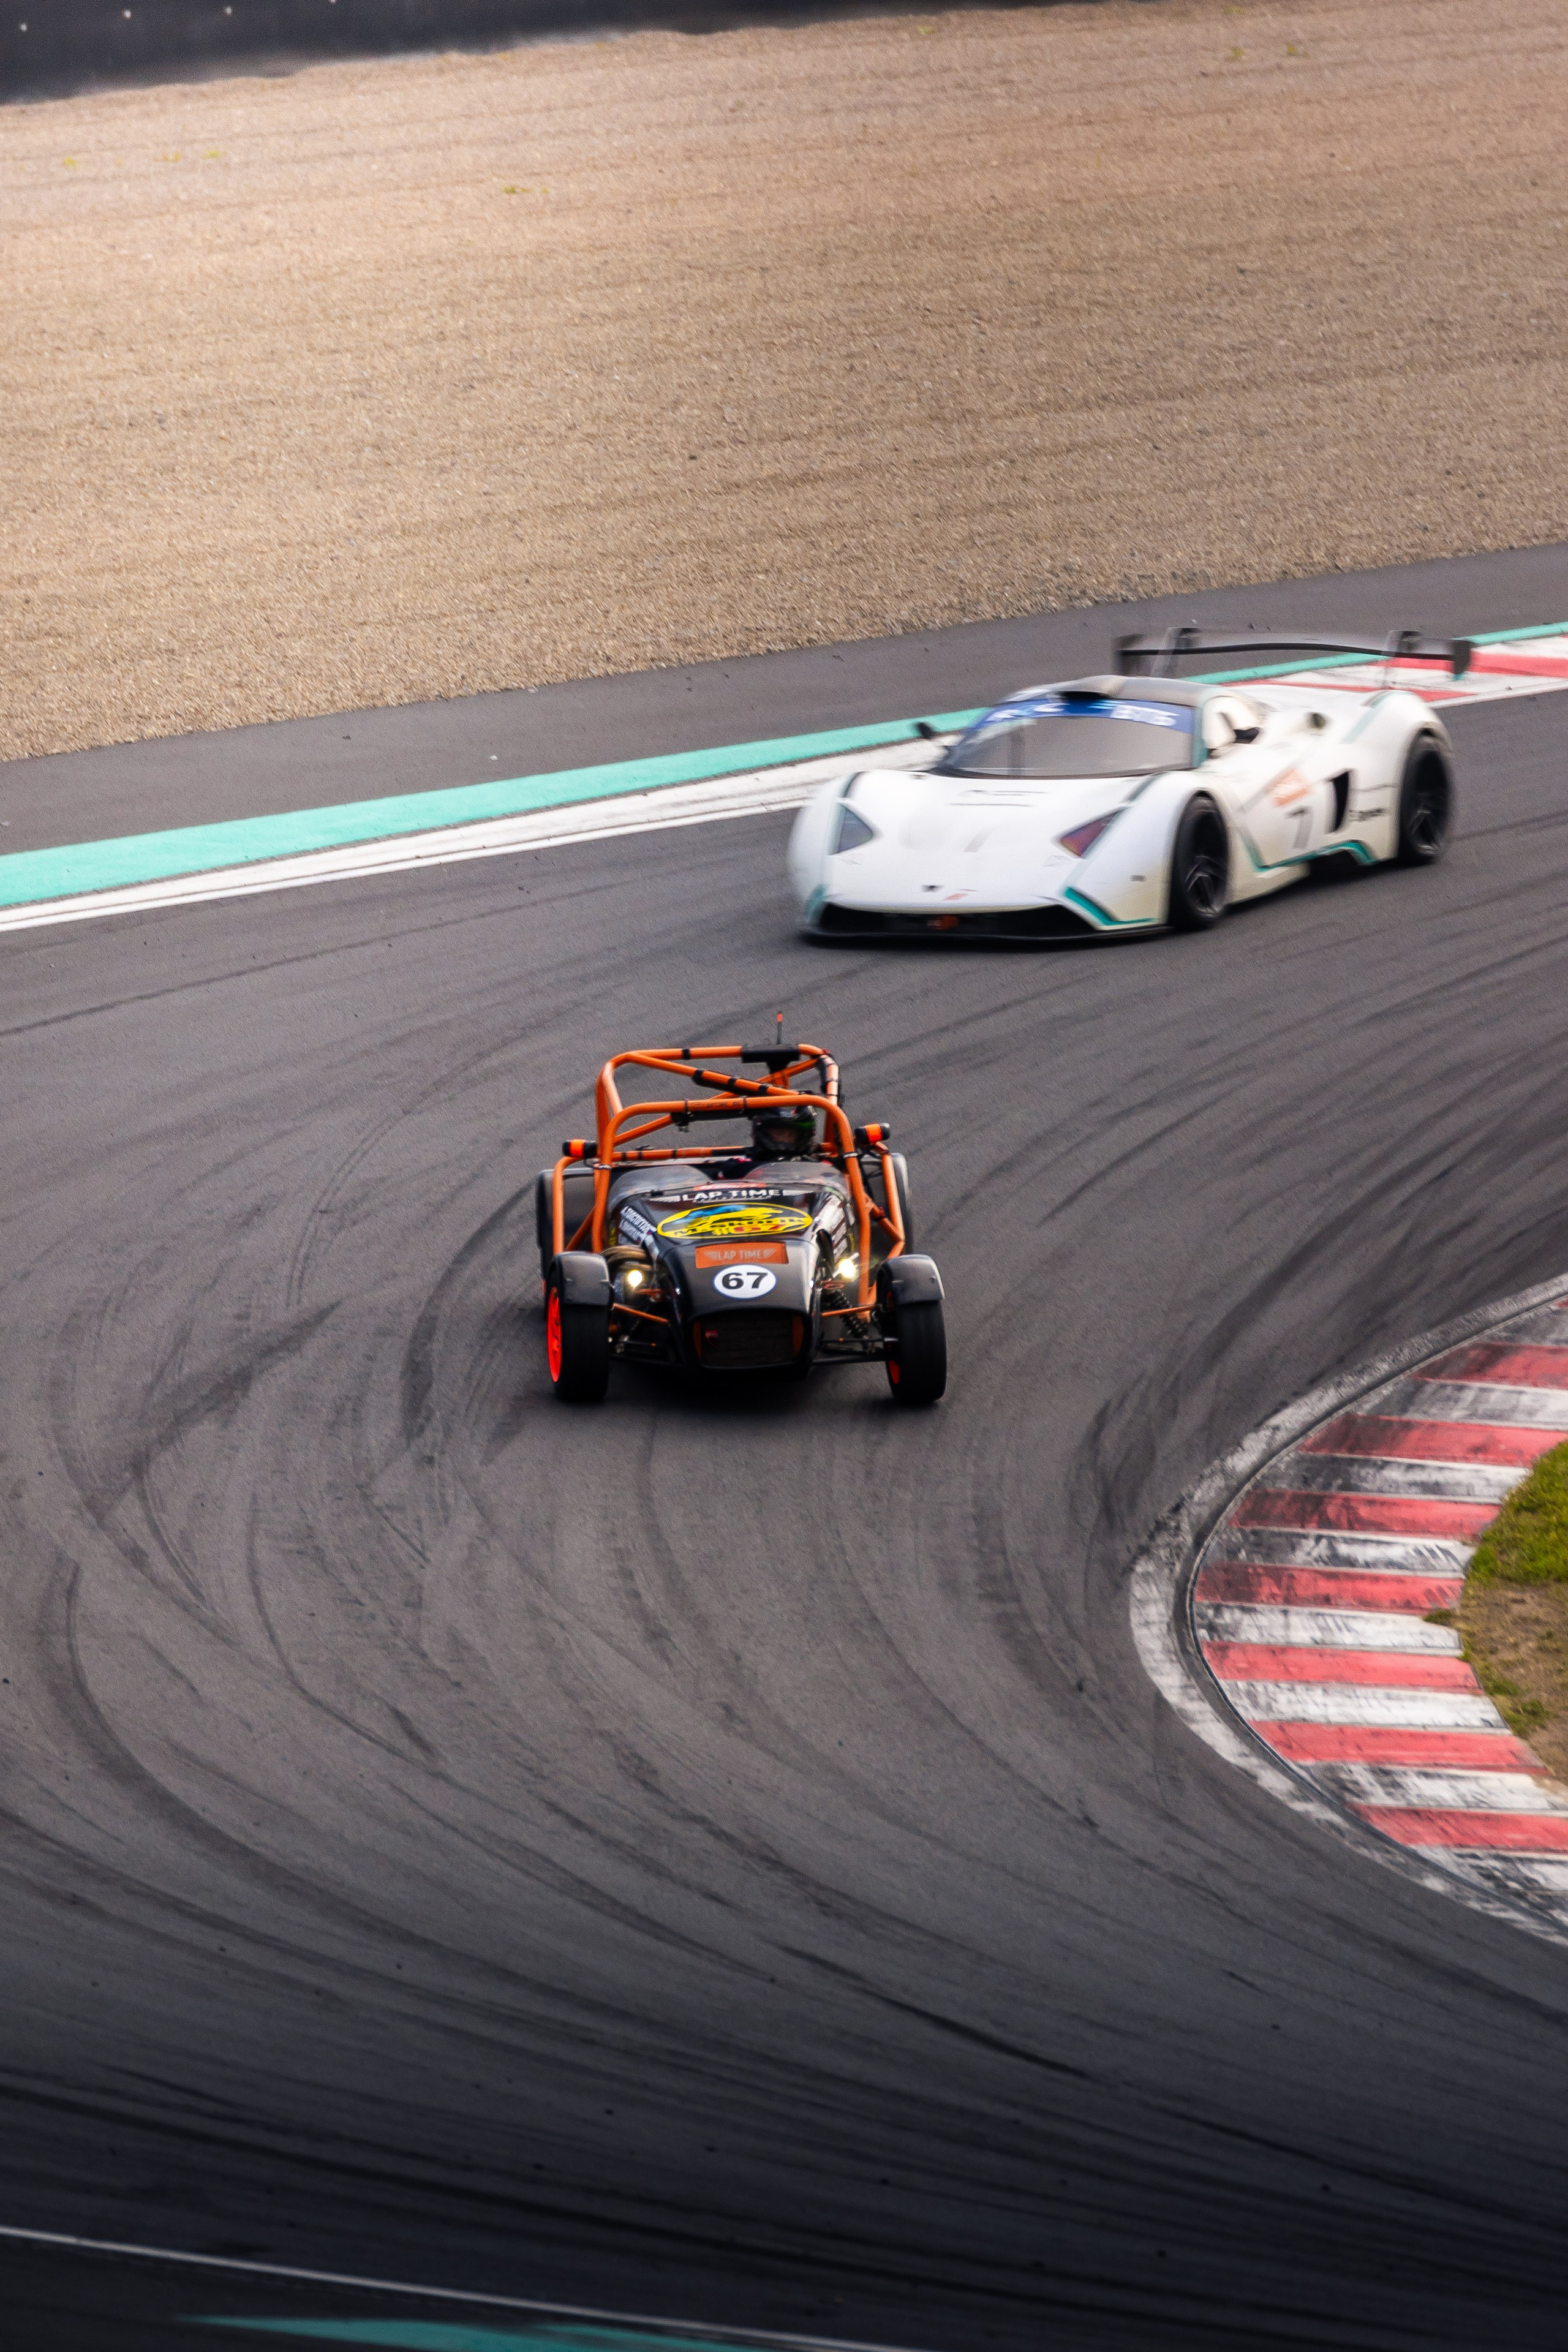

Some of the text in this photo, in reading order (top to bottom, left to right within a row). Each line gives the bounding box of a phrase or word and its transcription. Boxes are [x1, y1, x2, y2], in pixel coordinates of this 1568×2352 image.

[682, 1191, 722, 1201] LAP
[717, 1249, 762, 1260] LAP TIME
[722, 1272, 768, 1290] 67
